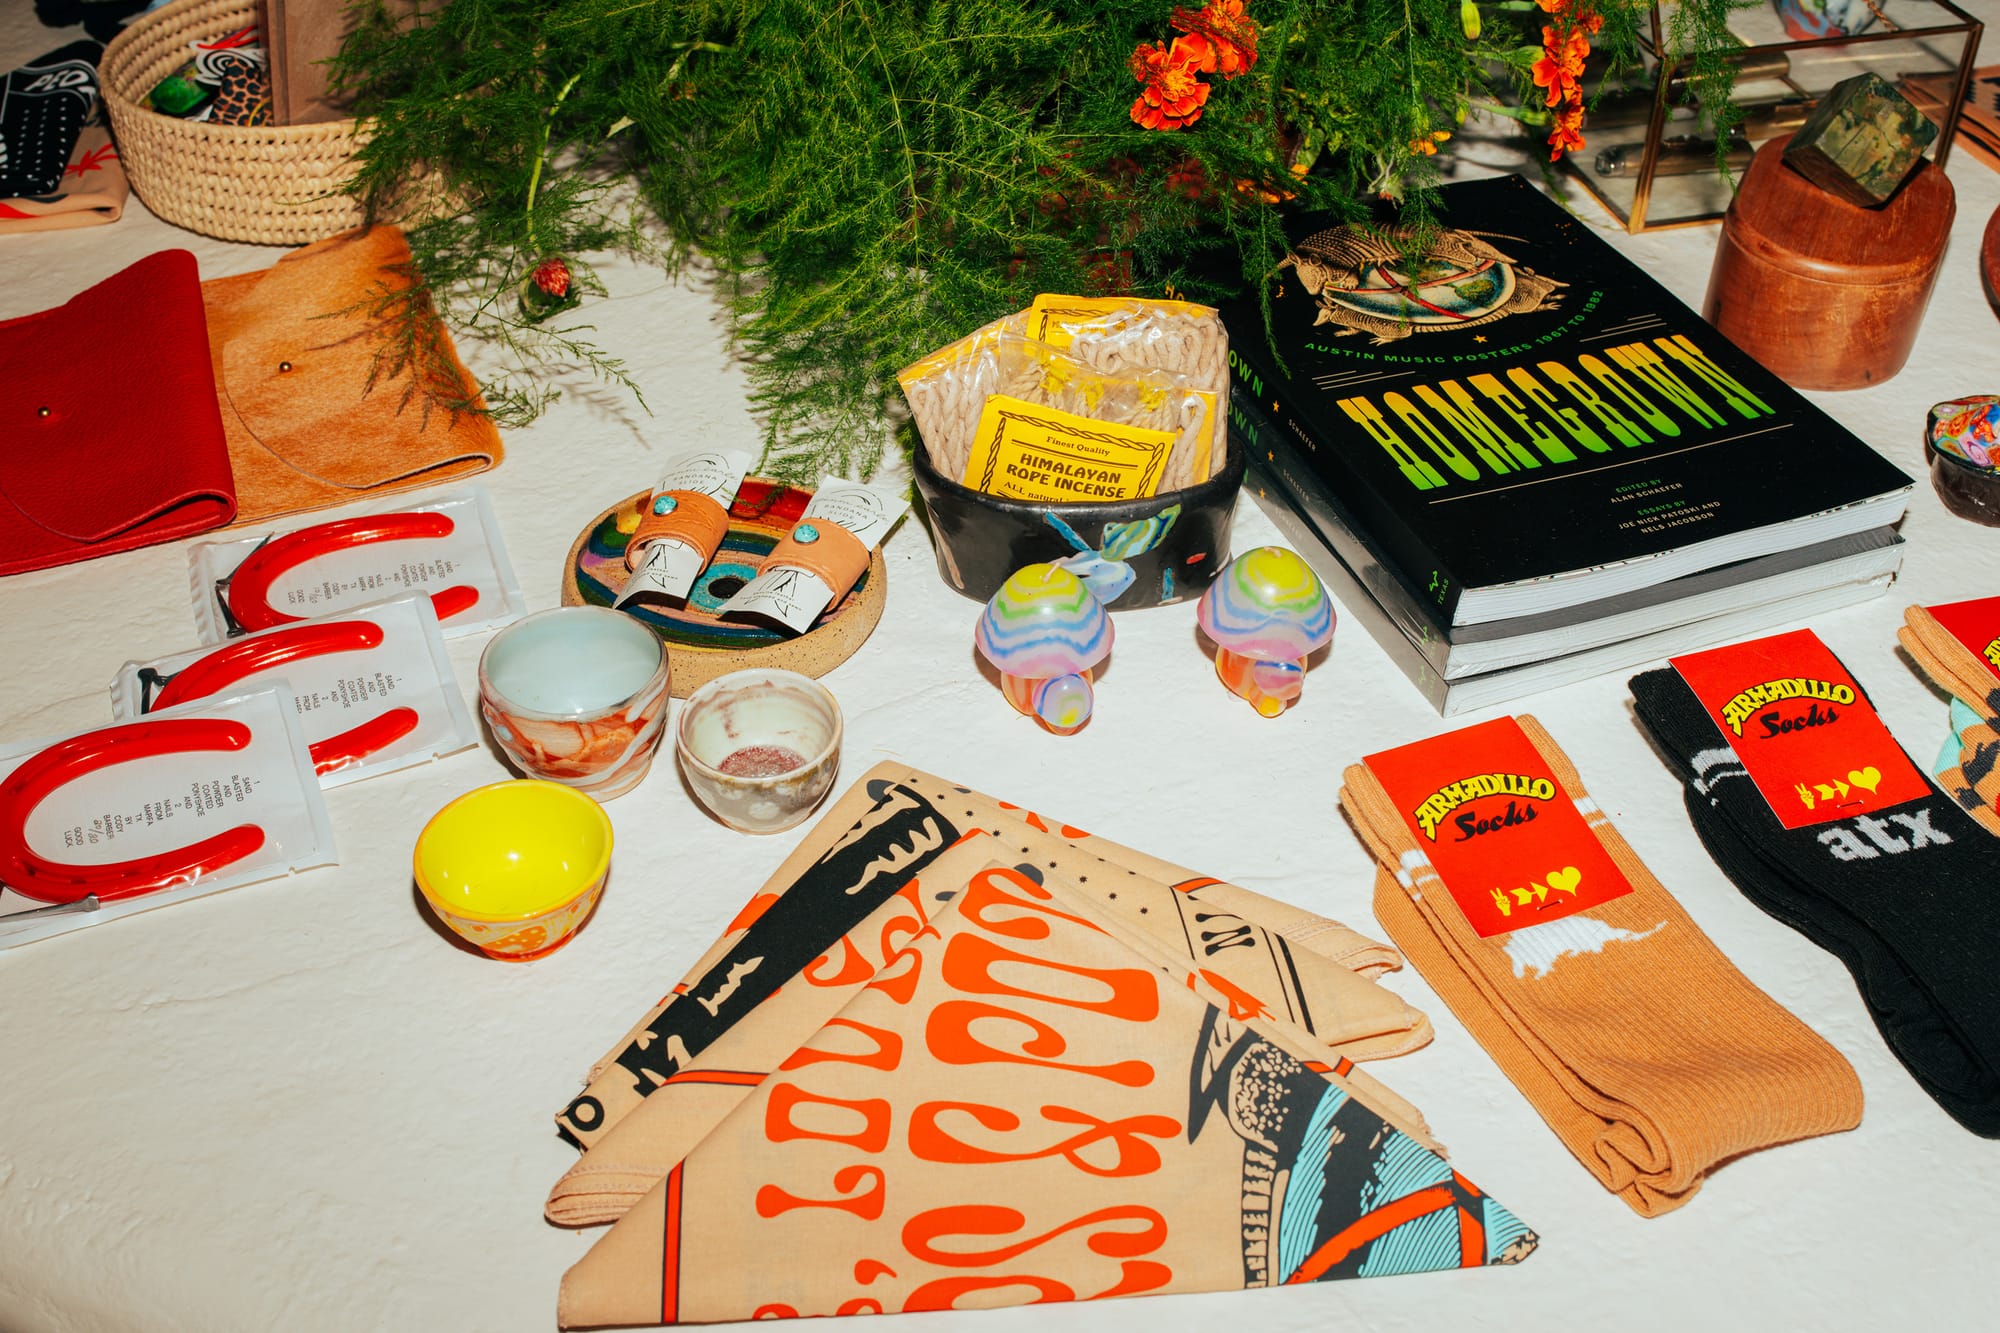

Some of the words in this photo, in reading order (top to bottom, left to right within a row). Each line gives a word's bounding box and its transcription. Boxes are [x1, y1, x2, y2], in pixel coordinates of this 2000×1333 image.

[1304, 342, 1375, 360] AUSTIN
[1384, 354, 1446, 364] MUSIC
[1453, 342, 1532, 363] POSTERS
[1535, 325, 1569, 345] 1967
[1568, 313, 1585, 327] TO
[1582, 290, 1604, 321] 1982
[1336, 334, 1777, 491] HOMEGROWN
[1046, 436, 1074, 450] Finest
[1077, 444, 1111, 457] Quality
[1288, 419, 1316, 452] SCHAEFER
[1020, 453, 1121, 484] HIMALAYAN
[1003, 481, 1025, 496] ALL
[1007, 464, 1050, 486] ROPE
[1054, 477, 1126, 498] INCENSE
[1615, 481, 1648, 493] EDITED
[1649, 479, 1662, 487] BY
[1610, 494, 1635, 504] ALAN
[1636, 482, 1683, 498] SCHAEFER
[824, 504, 867, 520] BANDANA
[1618, 521, 1636, 530] JOE
[1637, 515, 1660, 526] NICK
[1661, 506, 1700, 520] PATOSKI
[1702, 501, 1721, 511] AND
[1637, 503, 1673, 516] ESSAYS
[1674, 500, 1686, 508] BY
[1641, 524, 1665, 534] NELS
[1667, 511, 1715, 528] JACOBSON
[1437, 579, 1449, 606] TEXAS
[337, 679, 351, 708] PONYSHOE
[347, 680, 359, 702] COATED
[357, 677, 369, 701] POWDER
[368, 681, 376, 693] AND
[374, 672, 387, 696] BLASTED
[385, 675, 395, 690] SAND
[303, 695, 312, 711] FROM
[331, 691, 339, 702] AND
[1720, 678, 1856, 739] ARMADILLO
[1760, 704, 1839, 739] Socks
[202, 784, 214, 809] COATED
[212, 780, 224, 808] POWDER
[223, 785, 232, 798] AND
[231, 775, 244, 802] BLASTED
[242, 777, 252, 794] SAND
[164, 799, 173, 818] NAILS
[184, 796, 193, 809] AND
[192, 782, 205, 817] PONYSHOE
[1413, 772, 1556, 843] ARMADILLO
[124, 816, 133, 825] BY
[135, 813, 142, 822] TX
[144, 804, 154, 826] MARFA
[154, 802, 164, 821] FROM
[1454, 801, 1538, 842] Socks
[103, 814, 114, 839] BARBER
[114, 815, 124, 832] CODY
[64, 830, 73, 848] LUCK
[74, 826, 84, 846] GOOD
[1817, 808, 1954, 862] atx
[908, 1101, 1183, 1178] &
